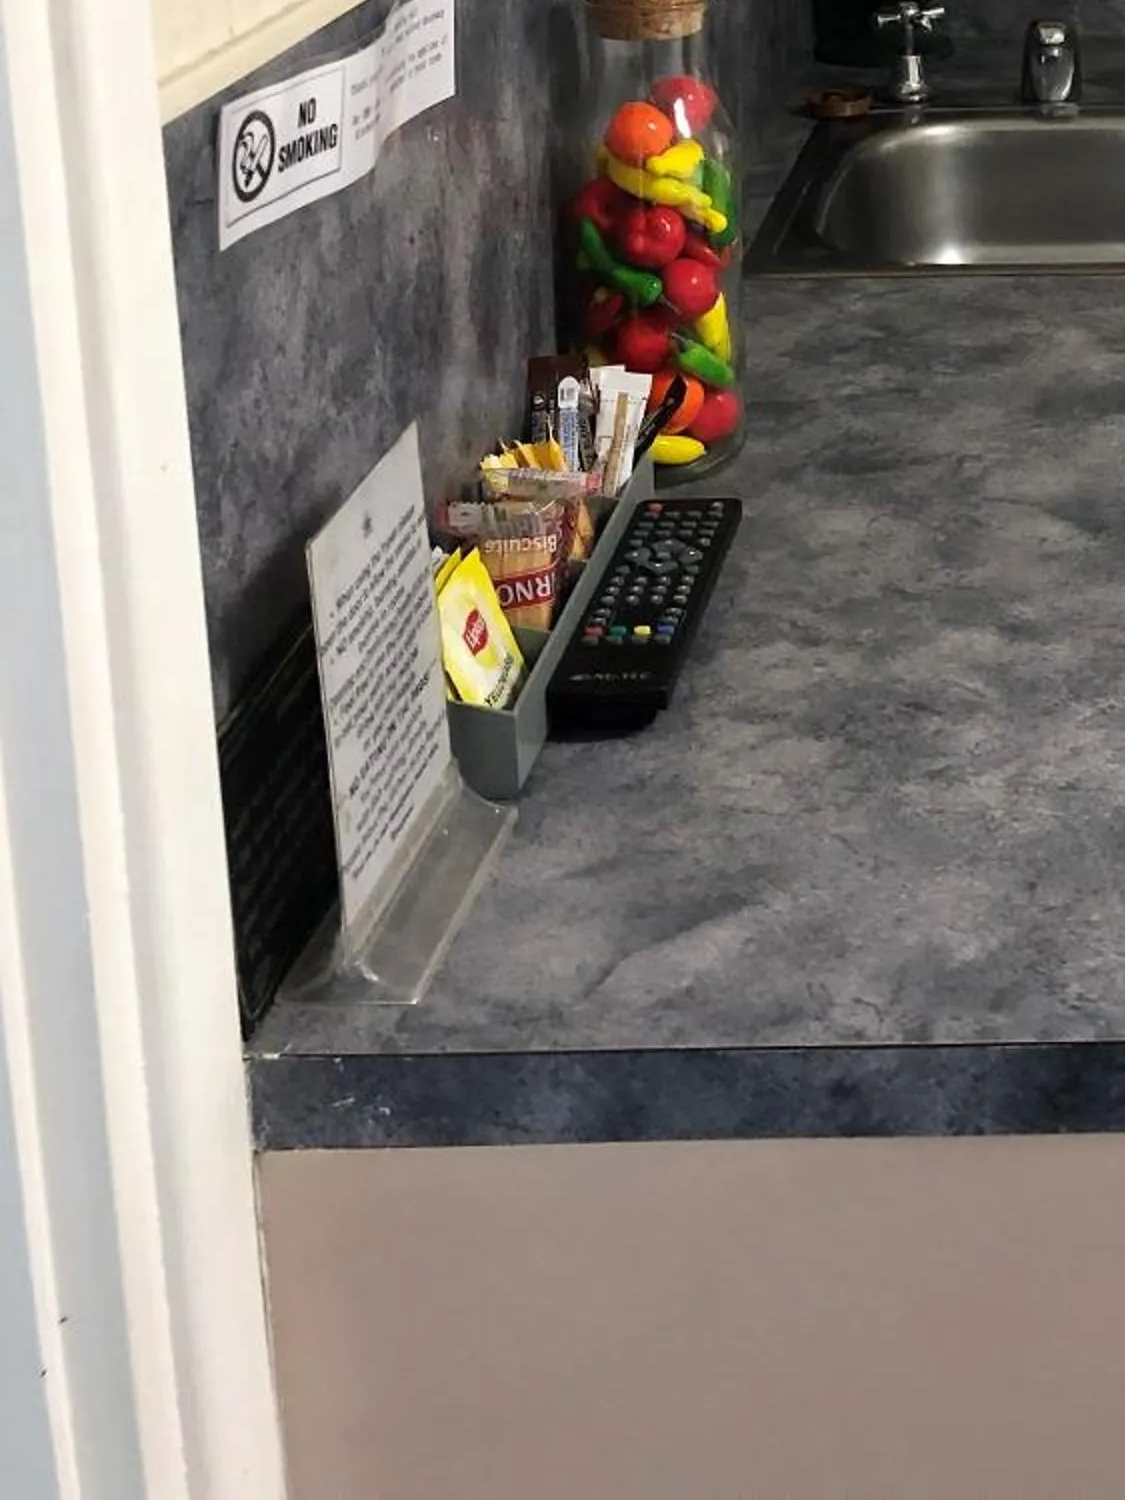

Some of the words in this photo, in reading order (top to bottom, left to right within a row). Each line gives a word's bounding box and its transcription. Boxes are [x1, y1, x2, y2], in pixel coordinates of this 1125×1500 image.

[298, 97, 317, 128] NO
[278, 123, 338, 173] SMOKING
[485, 534, 558, 553] Biscuits
[499, 572, 557, 608] RNO
